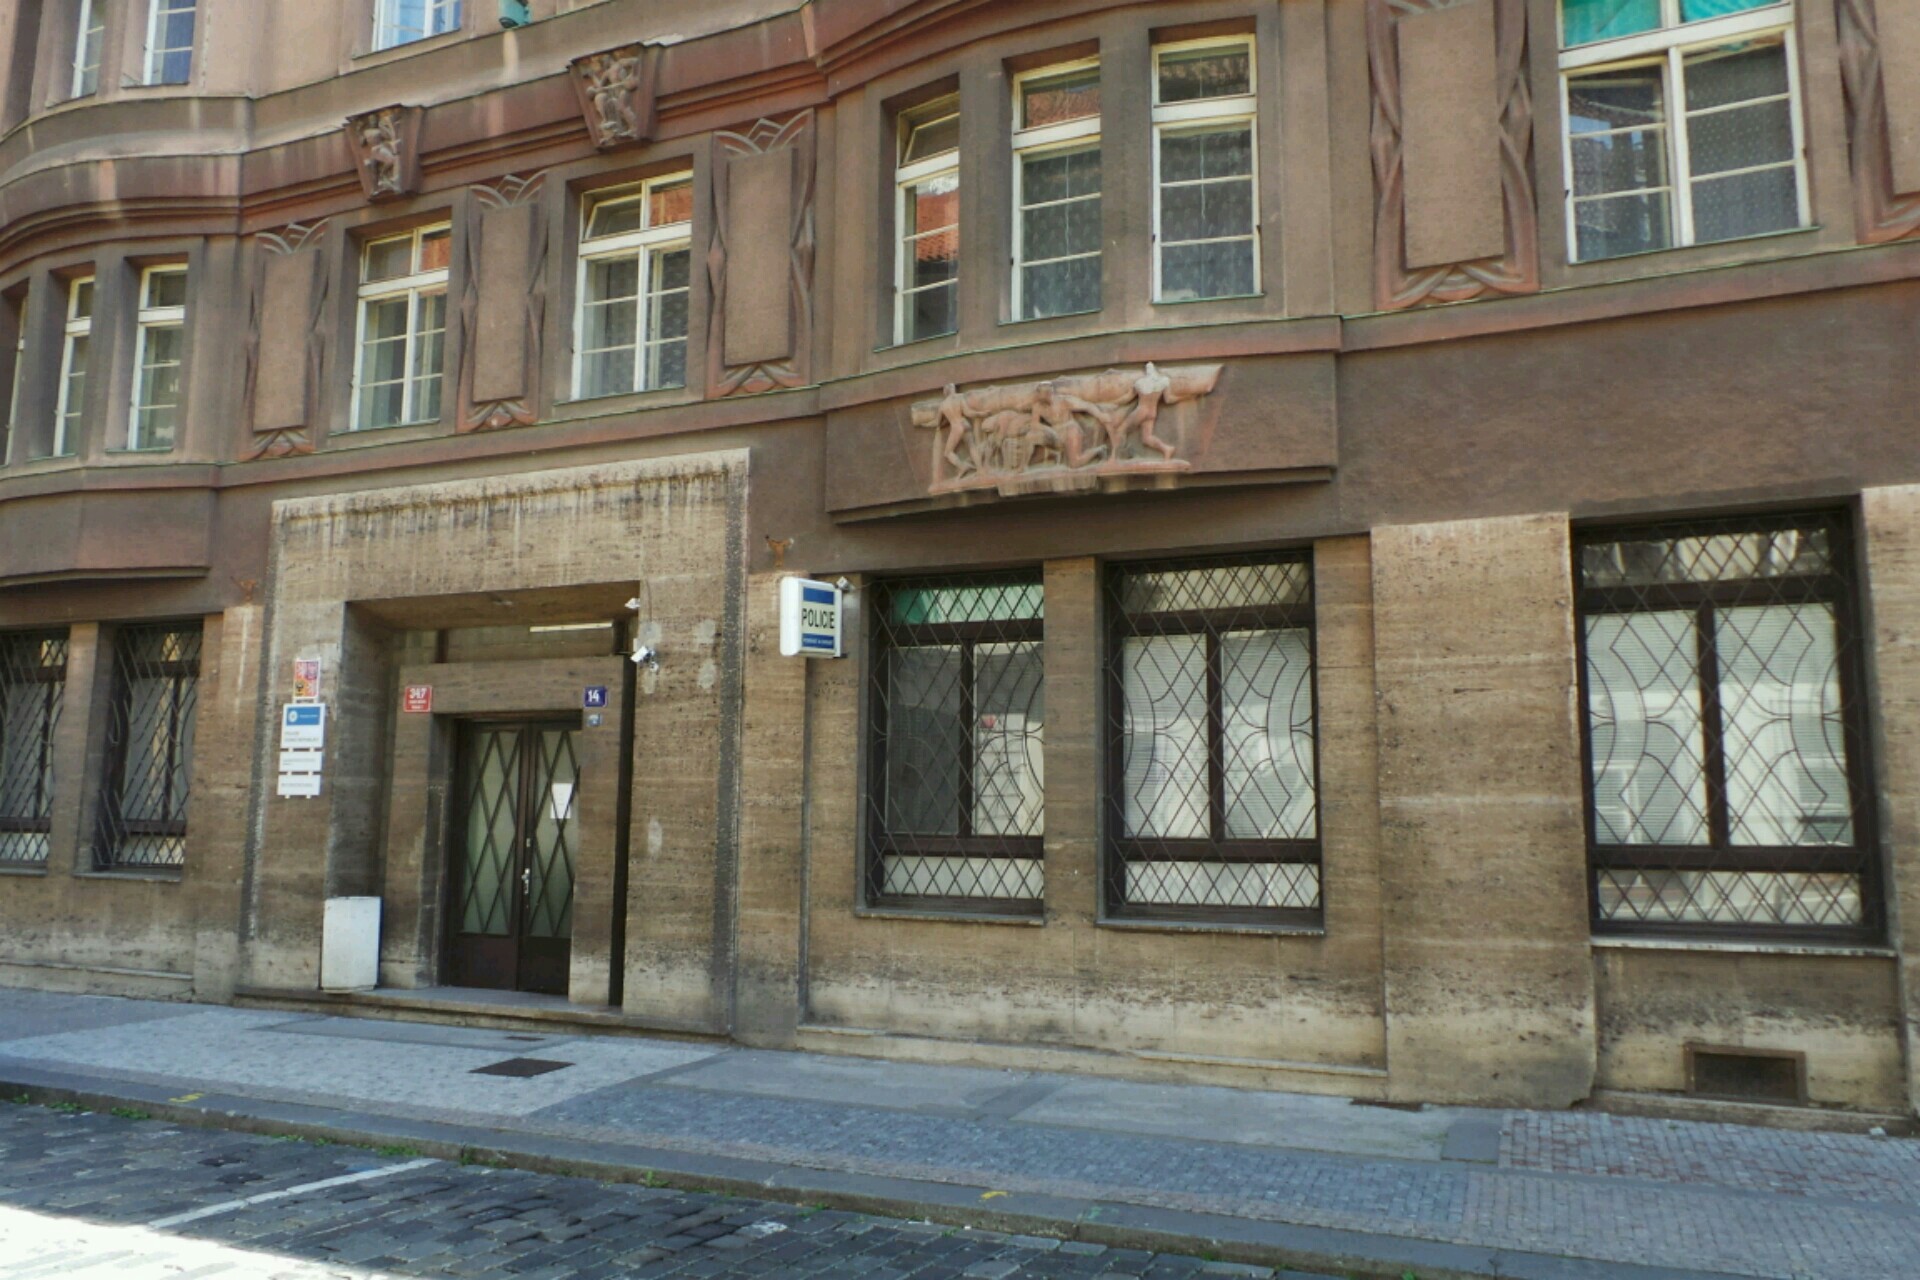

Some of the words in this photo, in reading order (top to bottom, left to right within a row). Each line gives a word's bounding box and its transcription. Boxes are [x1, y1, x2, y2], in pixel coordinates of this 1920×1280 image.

[801, 608, 835, 629] POLICIE
[409, 687, 426, 698] 347
[587, 688, 600, 703] 14
